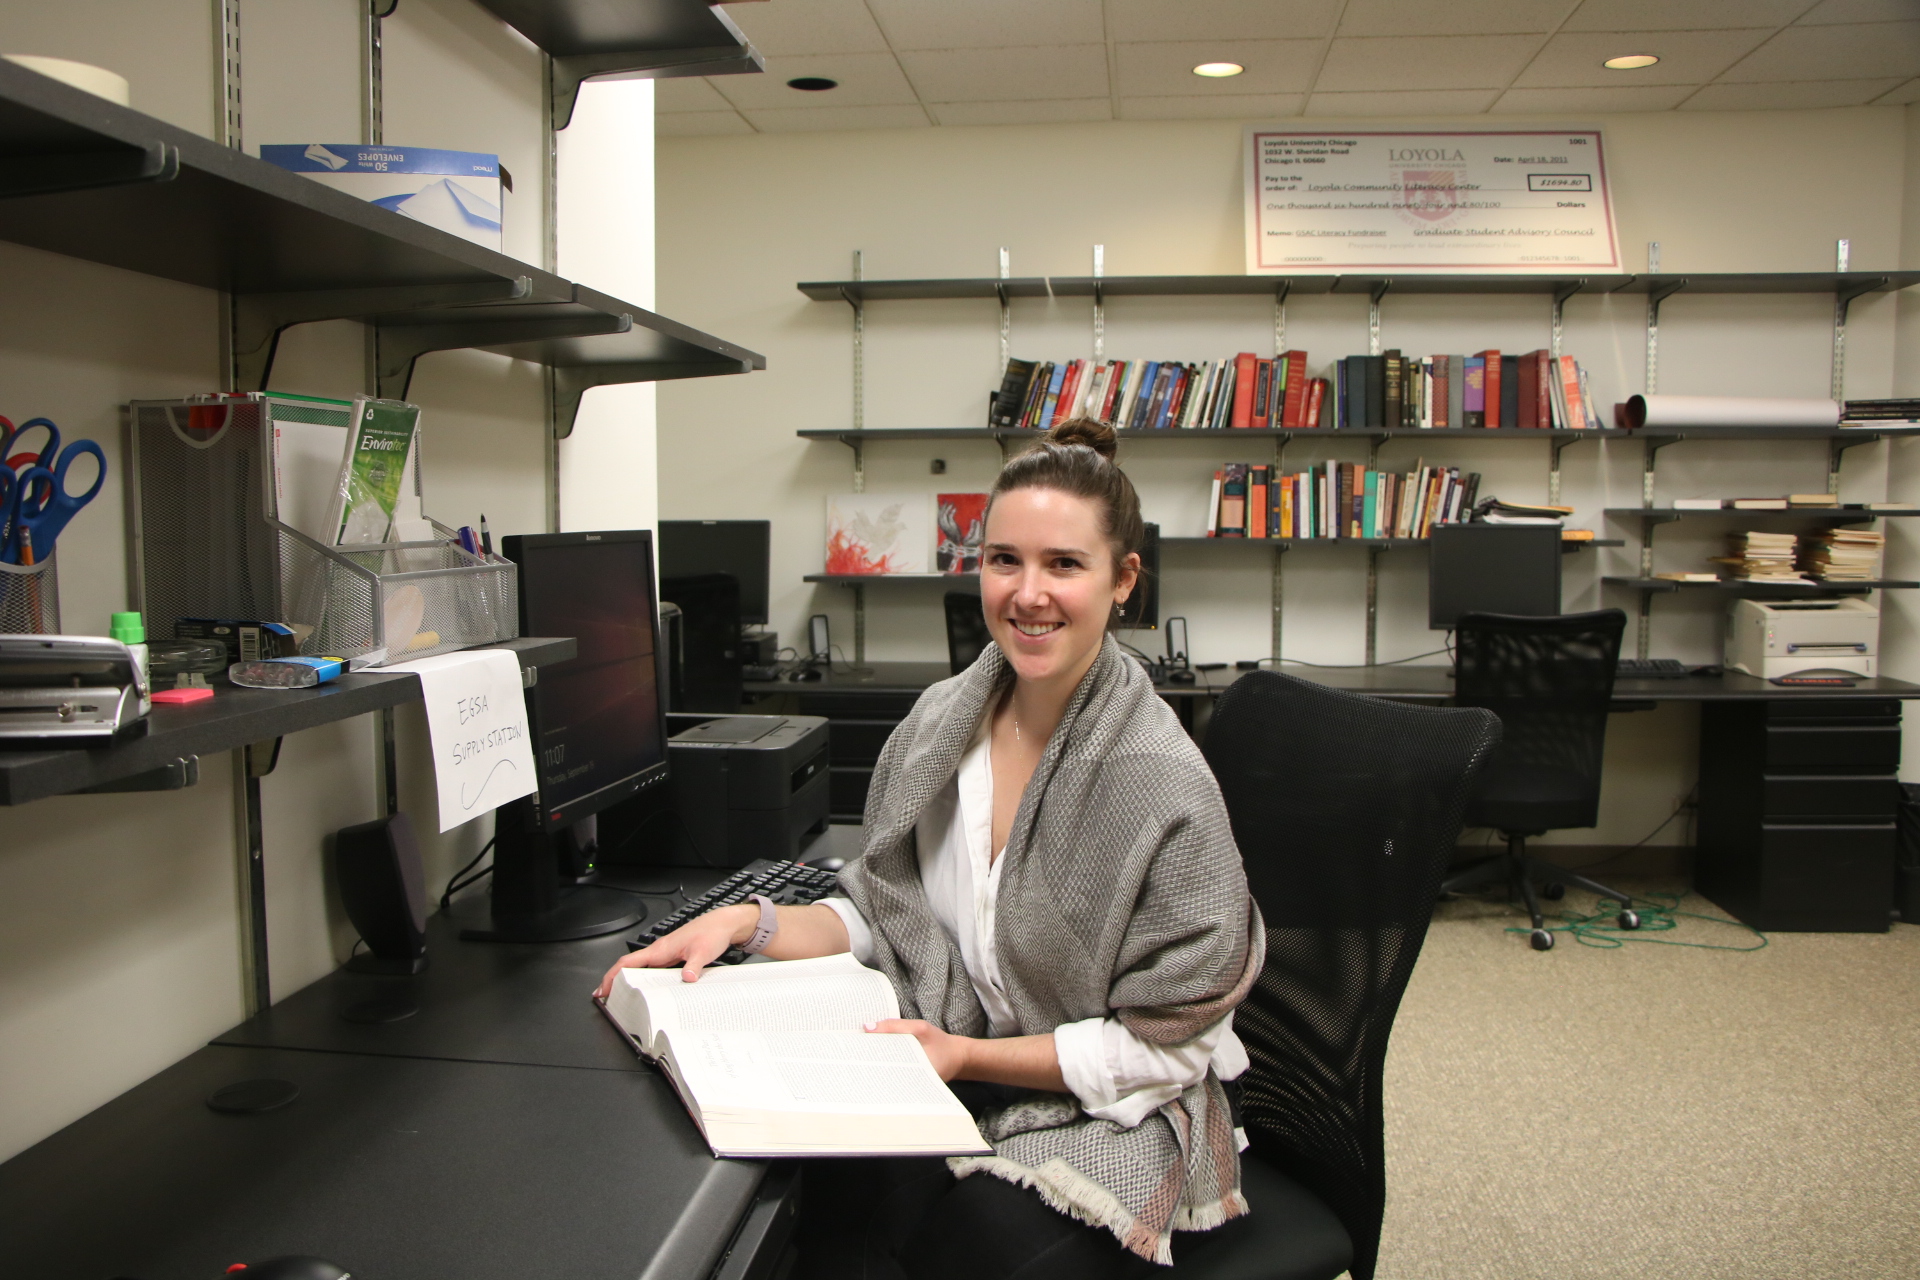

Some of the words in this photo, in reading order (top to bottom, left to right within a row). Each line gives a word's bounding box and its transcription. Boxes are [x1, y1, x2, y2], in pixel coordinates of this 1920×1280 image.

[1328, 139, 1357, 147] Chicago
[357, 153, 404, 162] ENVELOPES
[1389, 148, 1466, 161] LOYOLA
[1518, 156, 1535, 164] April
[375, 162, 388, 171] 50
[1308, 183, 1340, 192] Loyola
[1343, 183, 1402, 192] Community
[1405, 182, 1446, 191] Literacy
[1448, 183, 1482, 191] Center
[1287, 202, 1332, 210] thousand
[1392, 202, 1421, 211] ninety
[1447, 201, 1467, 209] and
[1318, 229, 1346, 237] Literacy
[1413, 228, 1464, 237] Graduate
[1466, 228, 1505, 236] Student
[1507, 227, 1551, 237] Advisory
[1553, 227, 1596, 236] Council
[457, 695, 489, 725] EGSA
[452, 737, 485, 766] SUPPLY
[487, 720, 522, 748] STATION
[545, 743, 565, 767] 11:07
